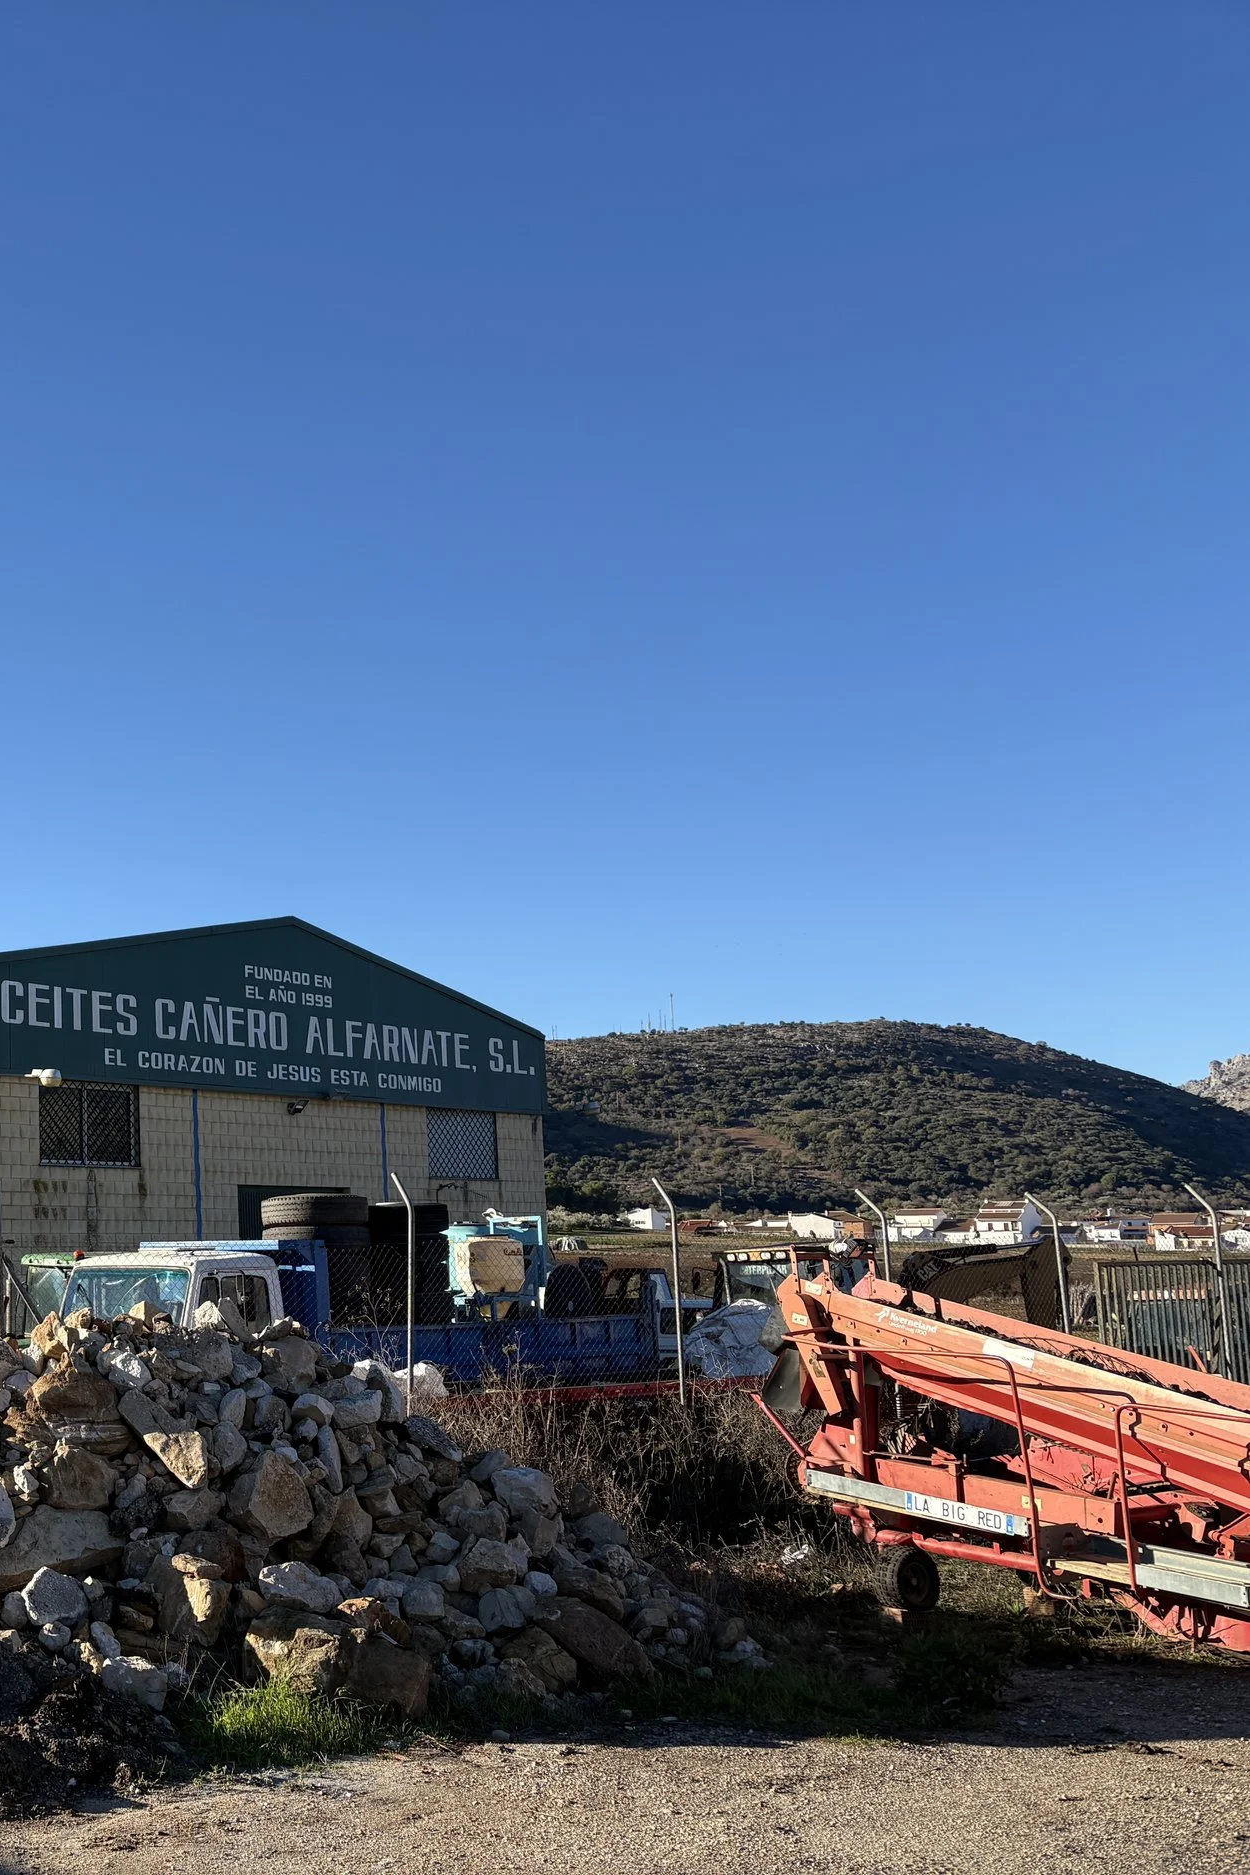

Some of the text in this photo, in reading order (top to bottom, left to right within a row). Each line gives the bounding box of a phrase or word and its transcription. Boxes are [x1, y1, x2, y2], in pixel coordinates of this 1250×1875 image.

[245, 964, 332, 989] FUNDADO EN
[245, 985, 333, 1008] EL AÑO 1999
[155, 996, 288, 1051] CAÑERO
[305, 1016, 477, 1073] ALFARNATE,
[488, 1037, 536, 1075] S.L.
[104, 1047, 442, 1093] EL CORAZON DE JESUS ESTA CONMIGO
[916, 1259, 940, 1281] CAT
[890, 1312, 937, 1334] Kverneland
[914, 1496, 1002, 1529] LA BIG RED
